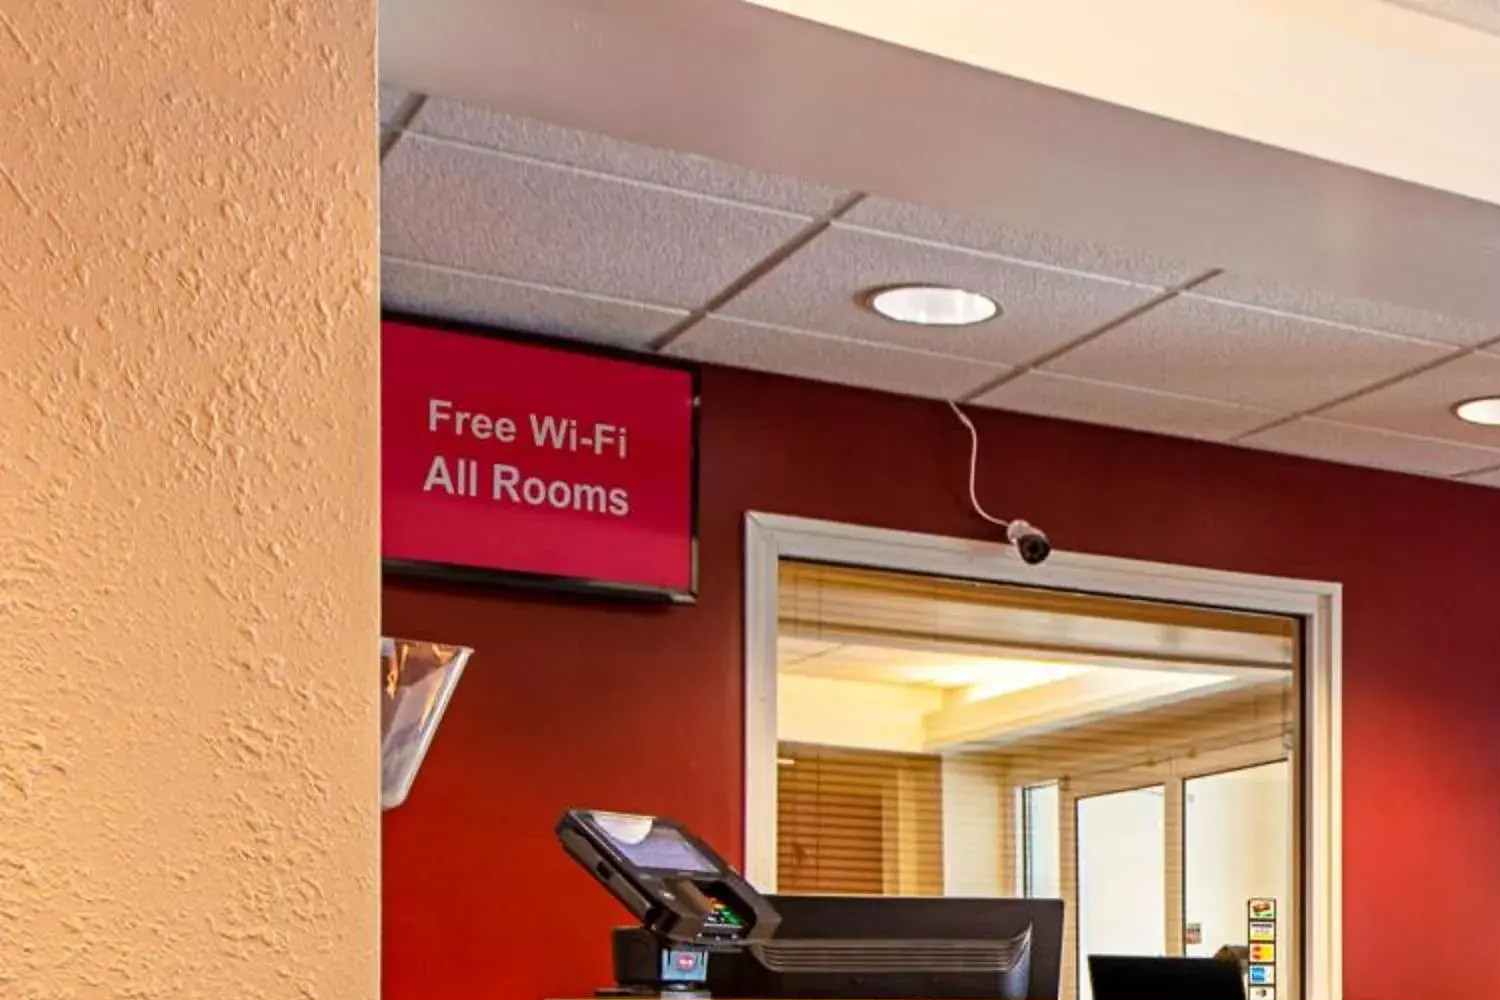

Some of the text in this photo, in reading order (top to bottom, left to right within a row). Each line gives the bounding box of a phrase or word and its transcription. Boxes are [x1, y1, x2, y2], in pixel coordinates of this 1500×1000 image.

[428, 398, 628, 460] Free Wi-Fi
[423, 456, 630, 516] All Rooms
